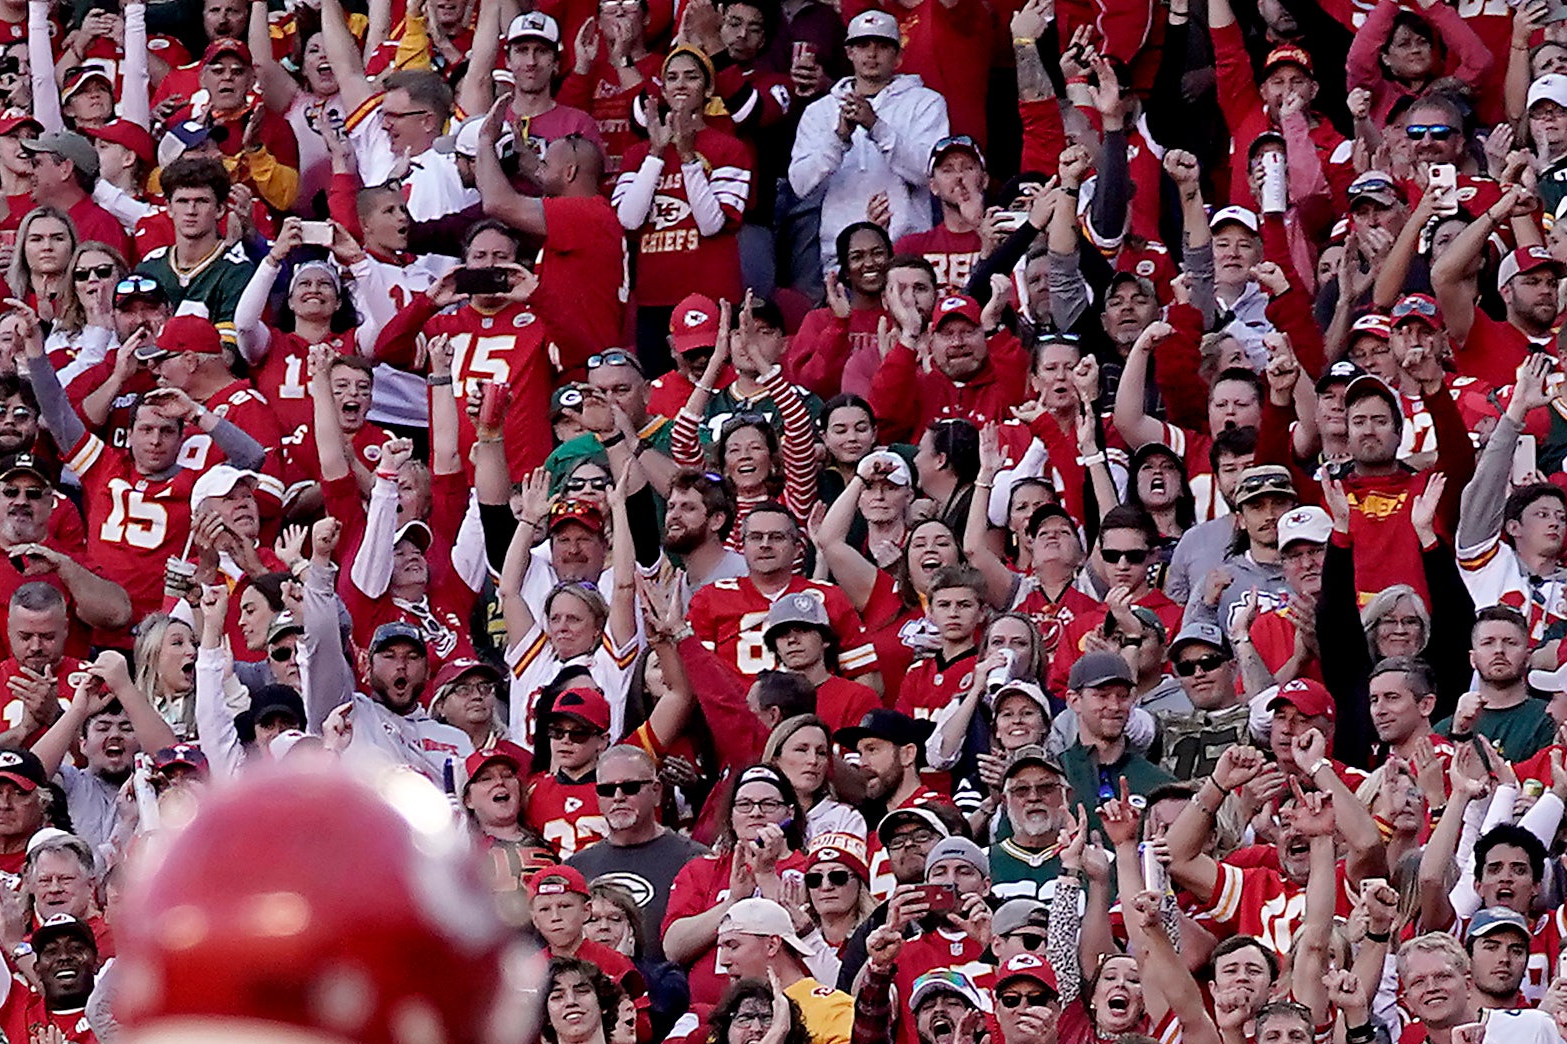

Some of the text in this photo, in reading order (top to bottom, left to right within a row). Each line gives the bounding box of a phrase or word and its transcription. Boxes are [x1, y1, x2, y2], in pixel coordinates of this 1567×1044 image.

[641, 229, 699, 253] CHIEFS
[449, 333, 517, 398] 15
[99, 478, 168, 549] 15
